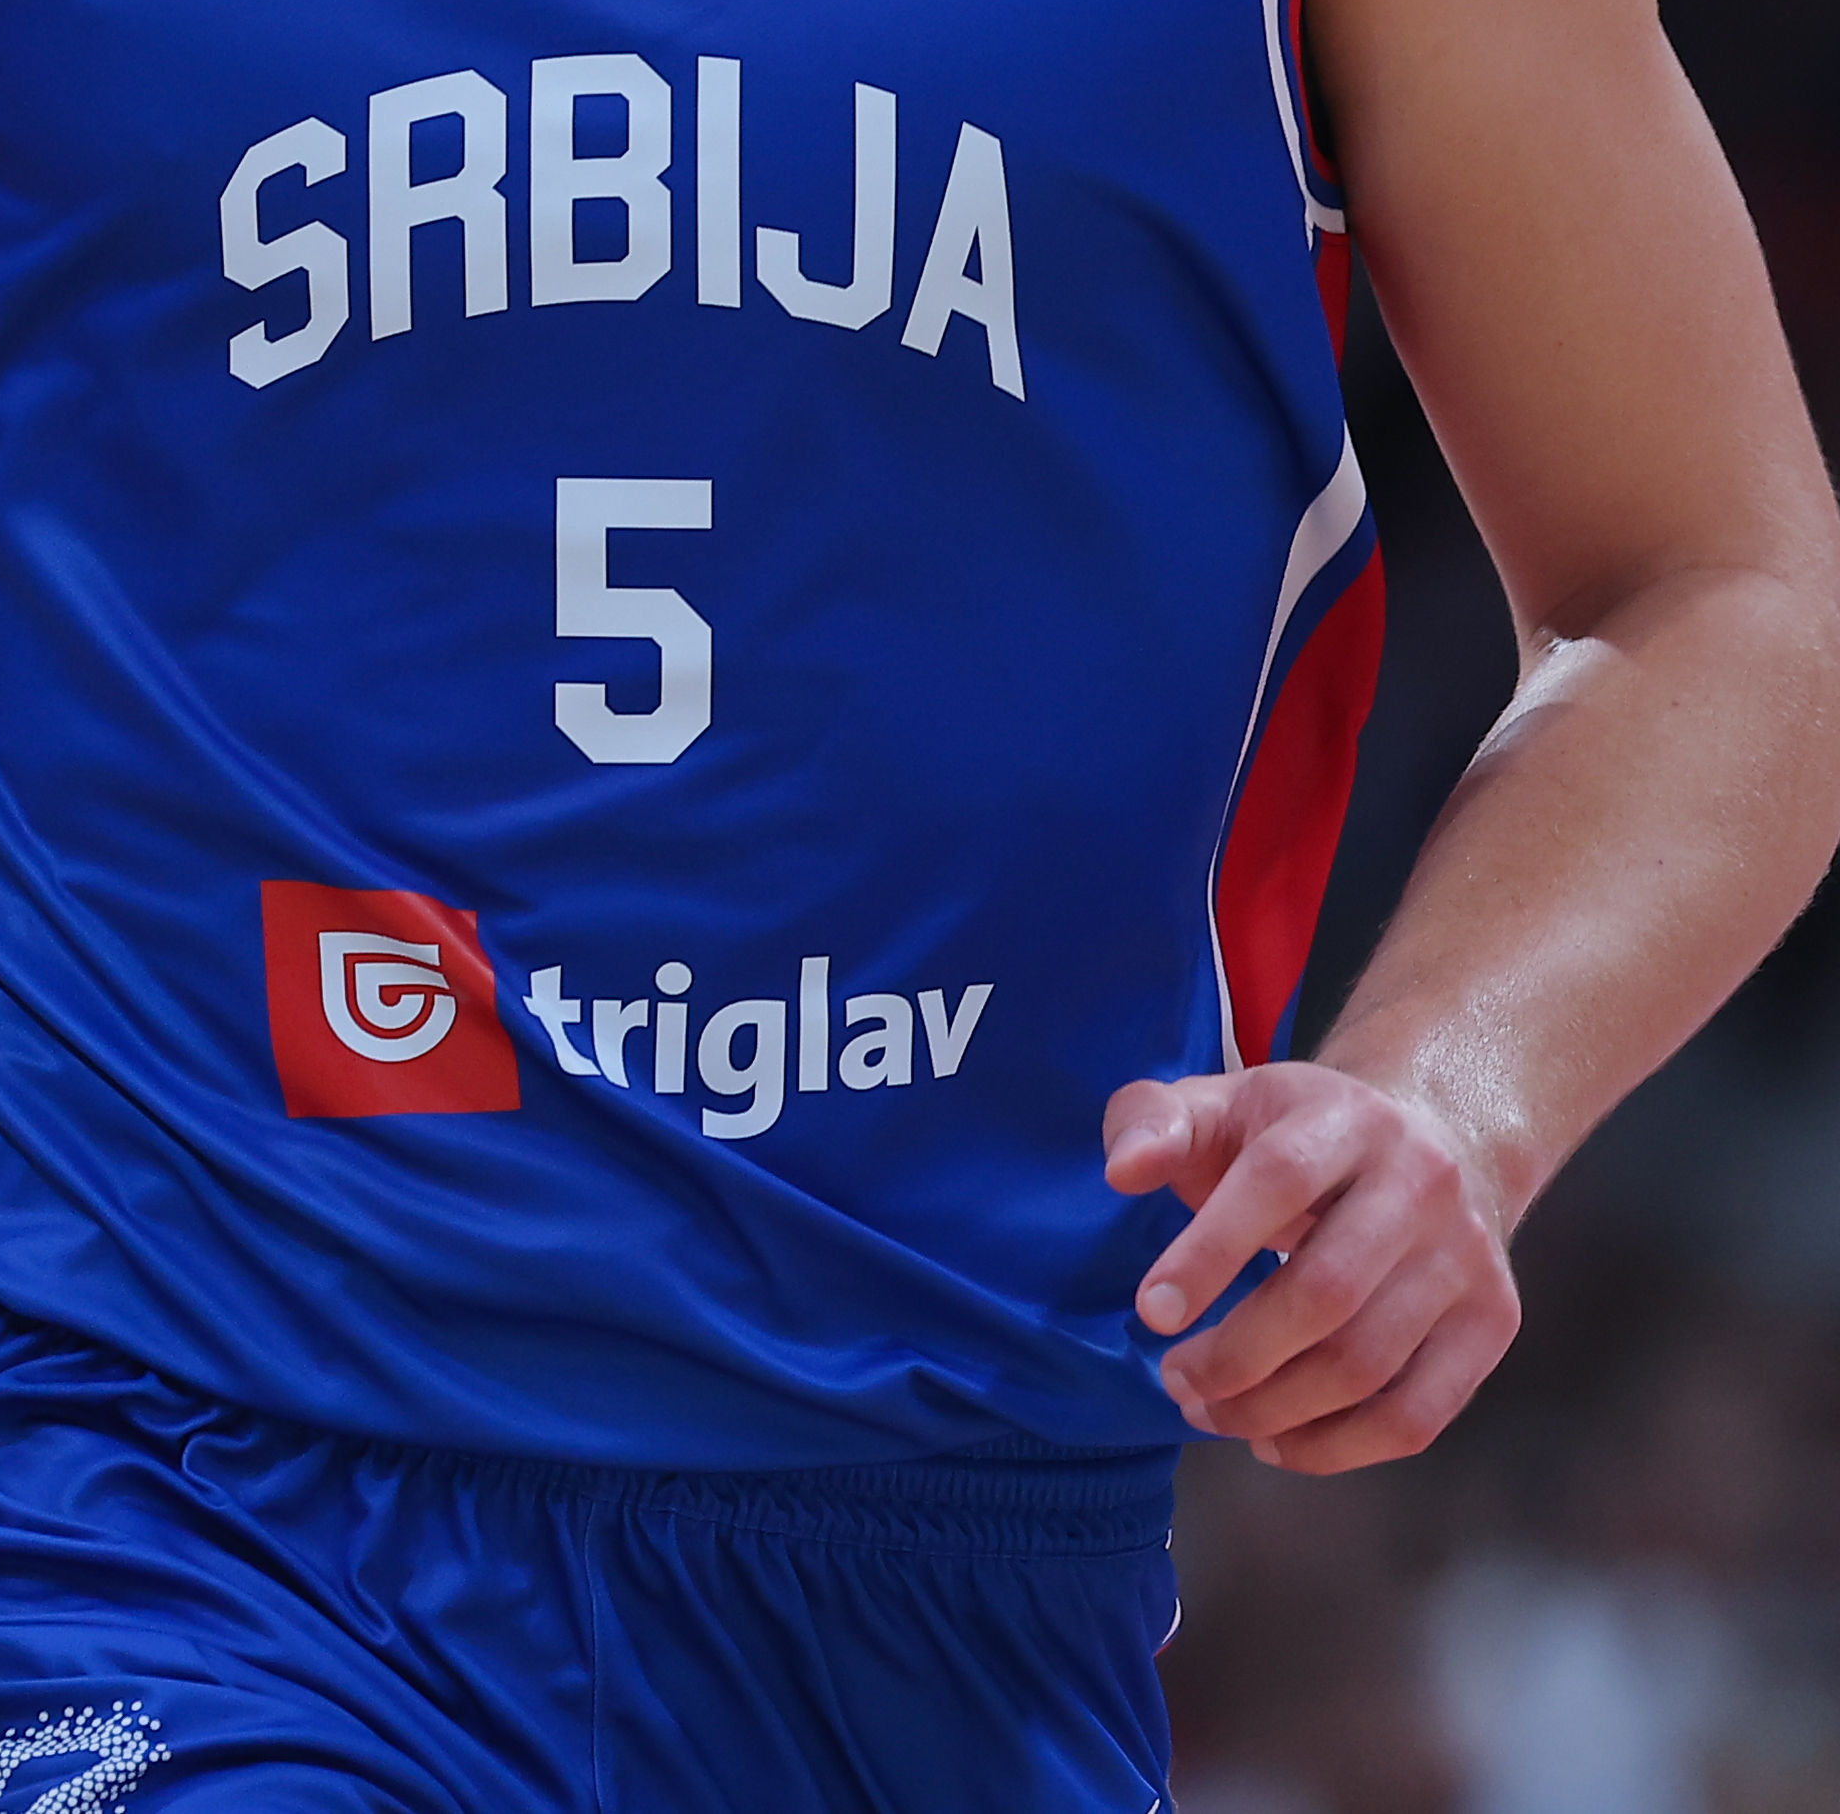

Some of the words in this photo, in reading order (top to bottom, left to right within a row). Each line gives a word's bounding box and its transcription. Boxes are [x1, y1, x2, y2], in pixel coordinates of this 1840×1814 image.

[220, 53, 1025, 402] SRBIJA
[555, 477, 713, 764] 5
[522, 955, 995, 1140] triglav
